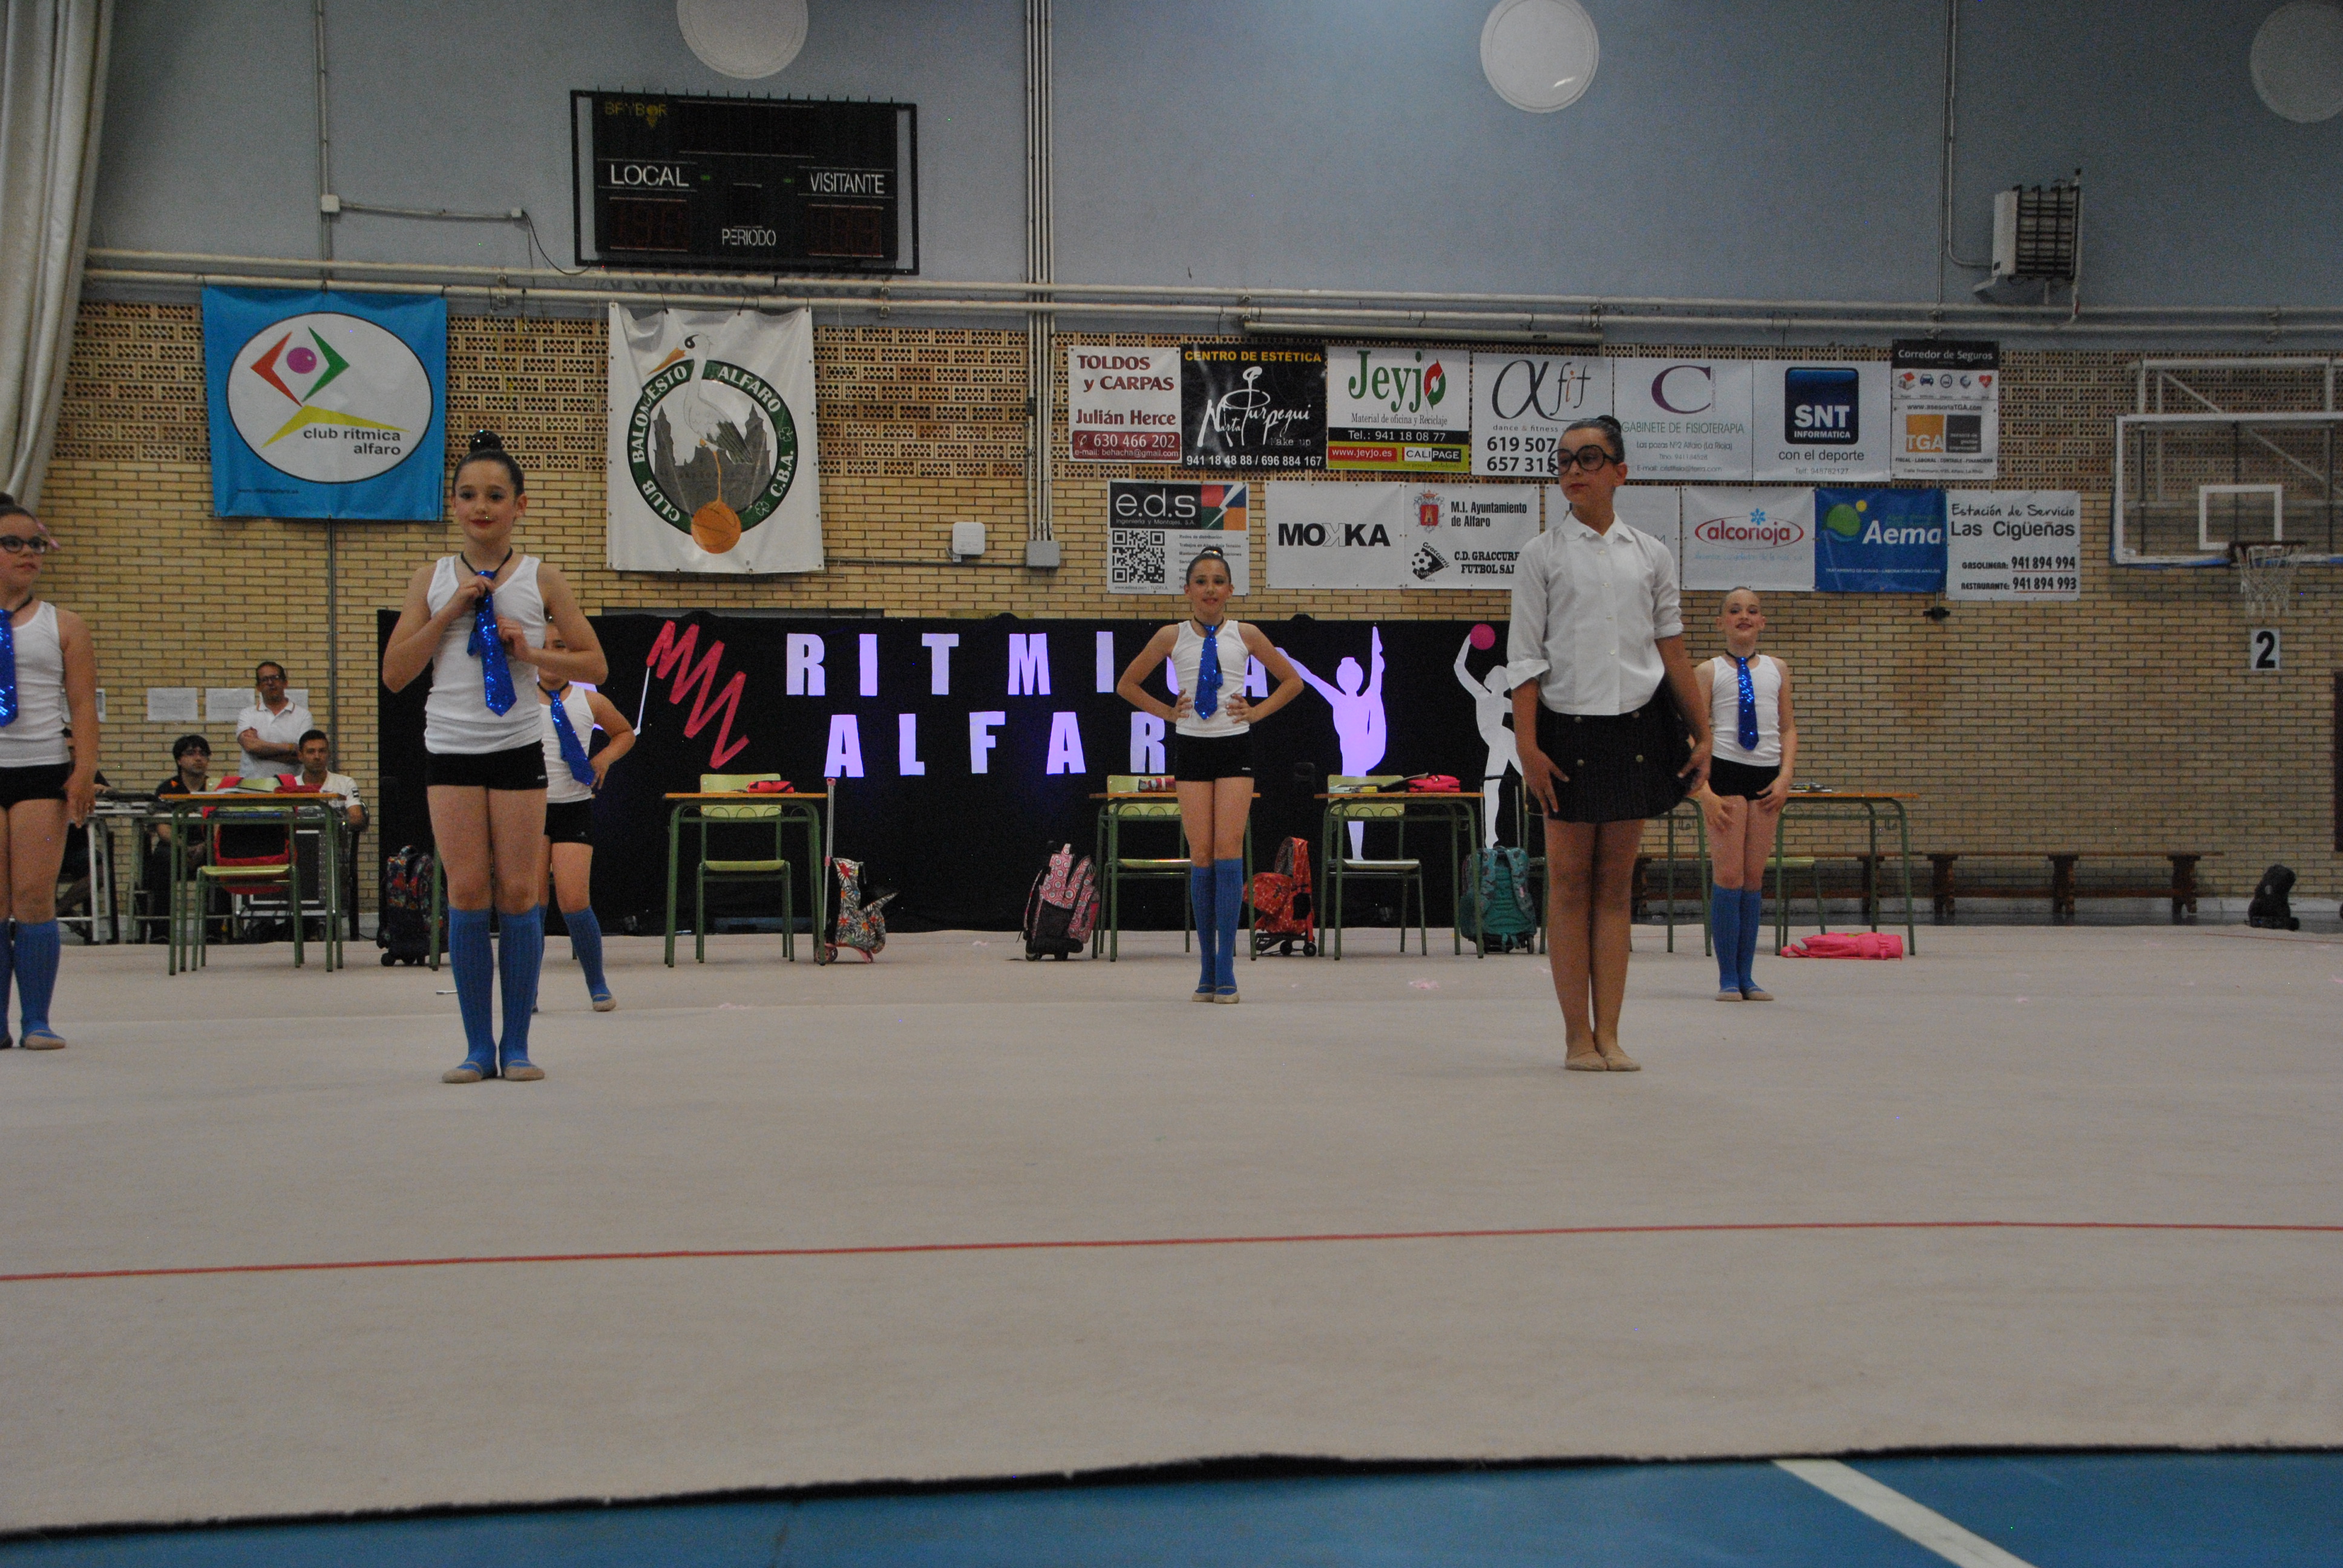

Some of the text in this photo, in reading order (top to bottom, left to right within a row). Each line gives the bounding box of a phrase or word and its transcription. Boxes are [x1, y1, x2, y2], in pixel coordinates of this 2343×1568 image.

[611, 164, 689, 187] LOCAL
[810, 172, 885, 194] VISITANTE
[1077, 355, 1150, 370] TOLDOS
[1185, 351, 1322, 362] CENTRO DE ESTÉTICA
[1898, 350, 1941, 359] Corredor
[1958, 351, 1993, 362] Seguros
[718, 366, 781, 413] ALFARO
[1084, 376, 1175, 392] y CARPAS
[1076, 408, 1176, 425] Julián Herce
[1351, 413, 1447, 426] Material de oficina y Reciclaje
[1795, 405, 1850, 428] SNT
[304, 428, 338, 439] club
[1621, 422, 1744, 434] GABINETE DE FISIOTERAPIA
[1094, 434, 1175, 448] 630 466 202
[1348, 430, 1446, 442] Tel.: 941 18 08 77
[1907, 434, 1944, 450] TGA
[353, 443, 401, 456] alfaro
[1487, 437, 1556, 453] 619 507
[1102, 448, 1179, 458] behacha@gmail.com
[1332, 448, 1392, 459] www.jeyjo.es
[1406, 450, 1460, 459] CALIPAGE
[1778, 450, 1864, 463] con el deporte
[1187, 455, 1204, 466] 941
[1210, 455, 1221, 466] 18
[1224, 456, 1236, 466] 48
[1240, 456, 1252, 466] 88
[1262, 456, 1279, 466] 696
[1283, 456, 1300, 466] 884
[1305, 456, 1322, 466] 167
[1487, 457, 1518, 472] 657
[771, 450, 793, 497] C.B.A.
[642, 480, 680, 521] CLUB
[1115, 488, 1196, 518] e.d.s
[1451, 502, 1527, 515] M.I. Ayuntamiento
[1951, 503, 2074, 517] Estación de Servicio
[1451, 516, 1490, 528] de Alfaro
[1707, 521, 1790, 545] alcorioja
[1862, 521, 1941, 544] Aema
[1951, 521, 2075, 540] Las Cigüeñas
[1454, 552, 1519, 561] C.D. GRACCUR
[2012, 557, 2029, 569] 941
[2033, 557, 2052, 569] 894
[2056, 557, 2075, 569] 994
[1461, 564, 1498, 573] FUTBOL
[2013, 577, 2030, 590] 941
[2034, 577, 2053, 590] 894
[2057, 577, 2077, 590] 993
[2256, 631, 2275, 668] 2
